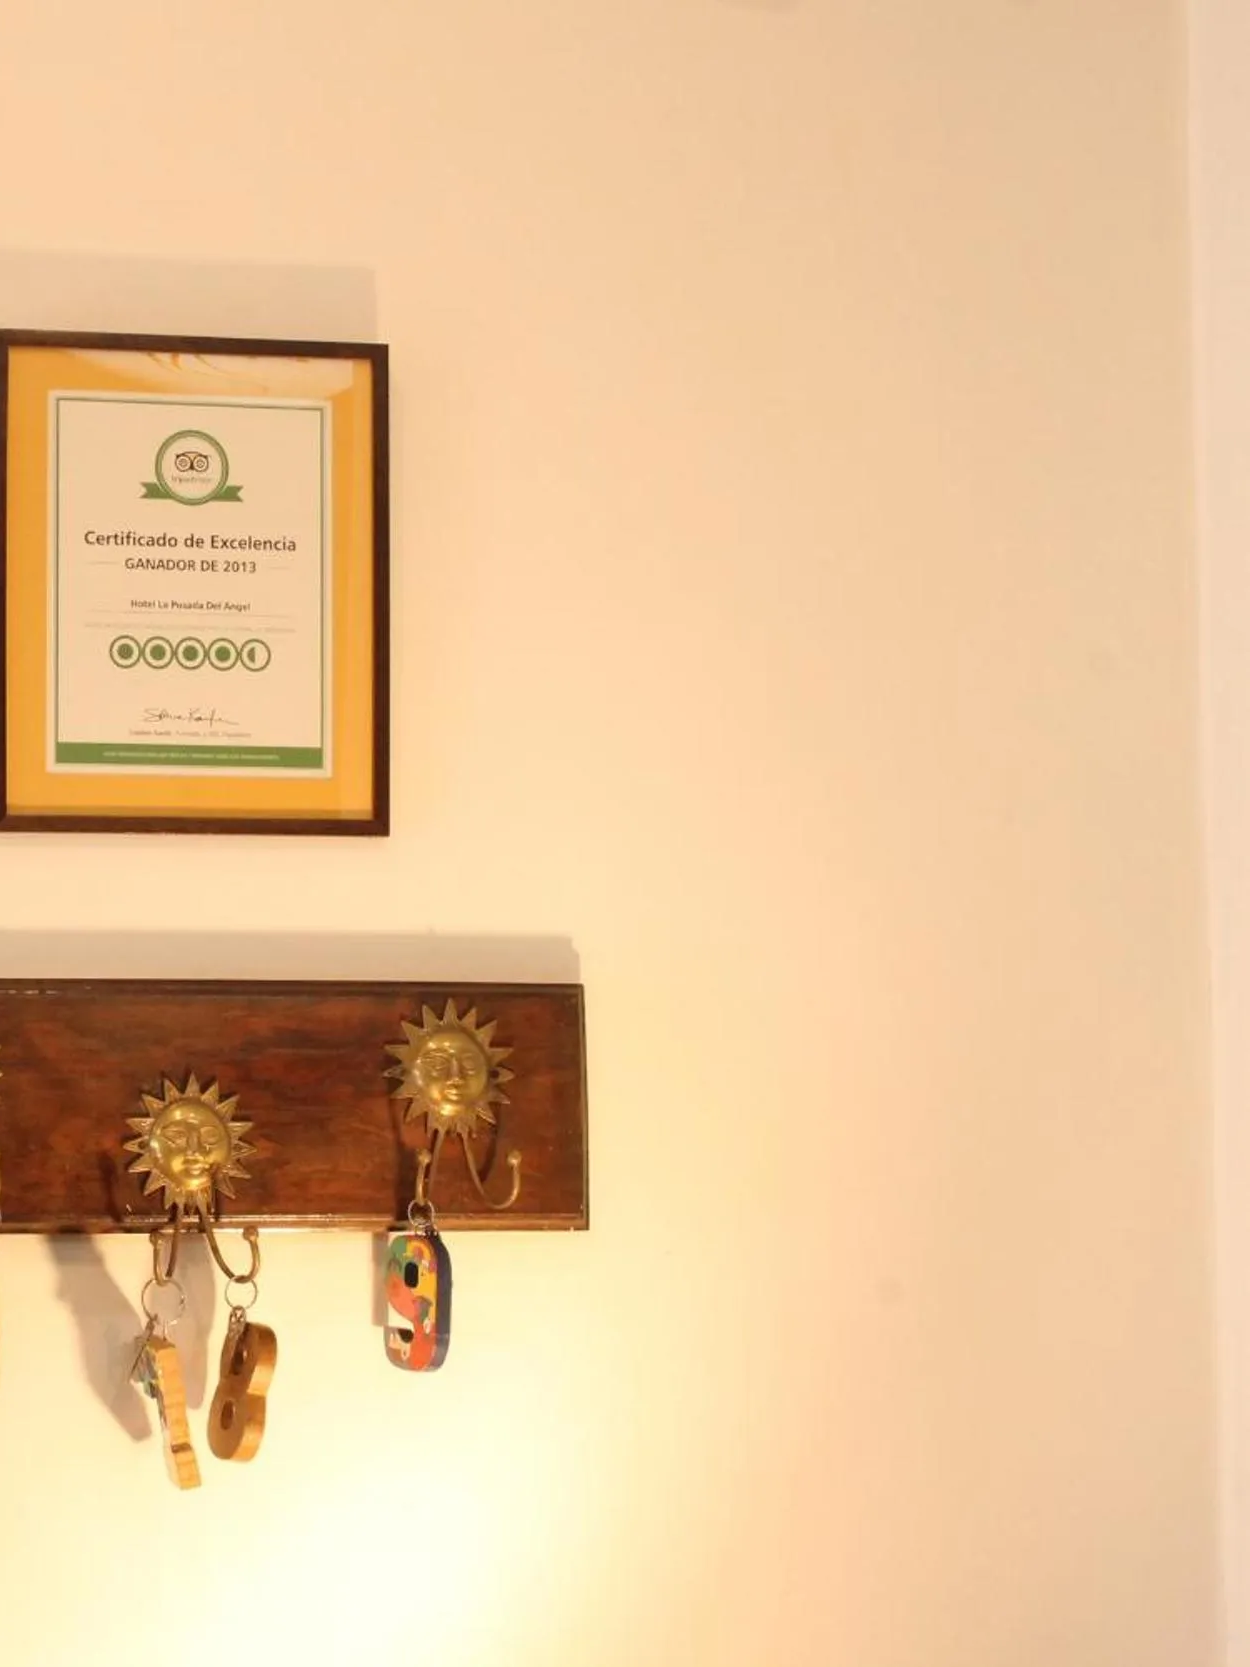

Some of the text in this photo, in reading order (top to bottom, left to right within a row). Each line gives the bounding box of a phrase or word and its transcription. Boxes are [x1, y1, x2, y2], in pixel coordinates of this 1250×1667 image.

[84, 530, 297, 552] Certificado de Excelencia
[125, 558, 257, 574] GANADOR DE 2013
[130, 599, 155, 610] Hotel
[383, 1232, 452, 1373] 9
